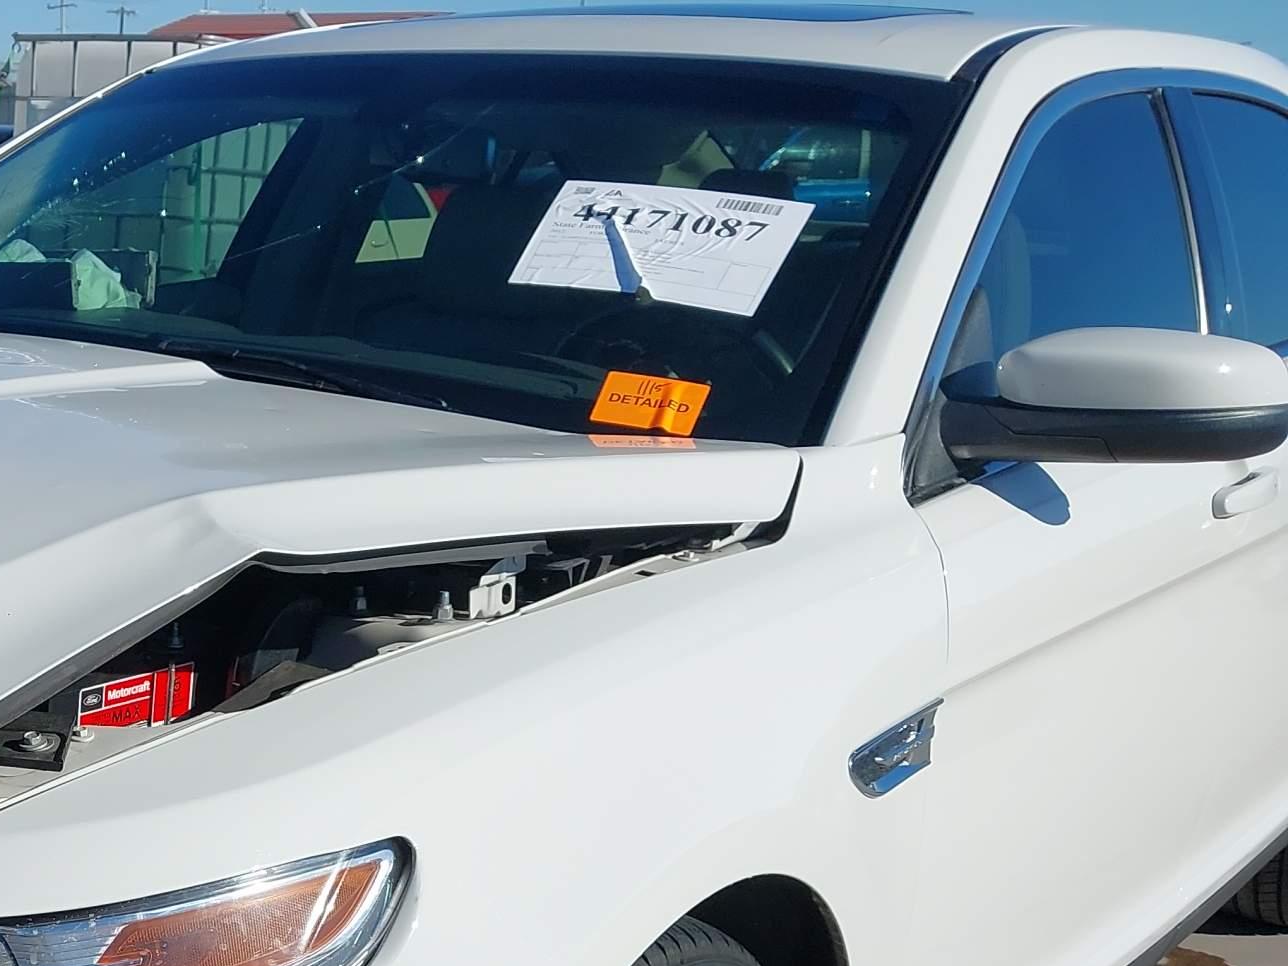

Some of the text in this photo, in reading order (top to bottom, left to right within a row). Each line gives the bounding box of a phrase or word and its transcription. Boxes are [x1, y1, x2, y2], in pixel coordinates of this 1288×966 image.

[608, 392, 690, 414] DETAILED
[107, 680, 151, 700] Motorcraft
[112, 706, 141, 722] MAX
